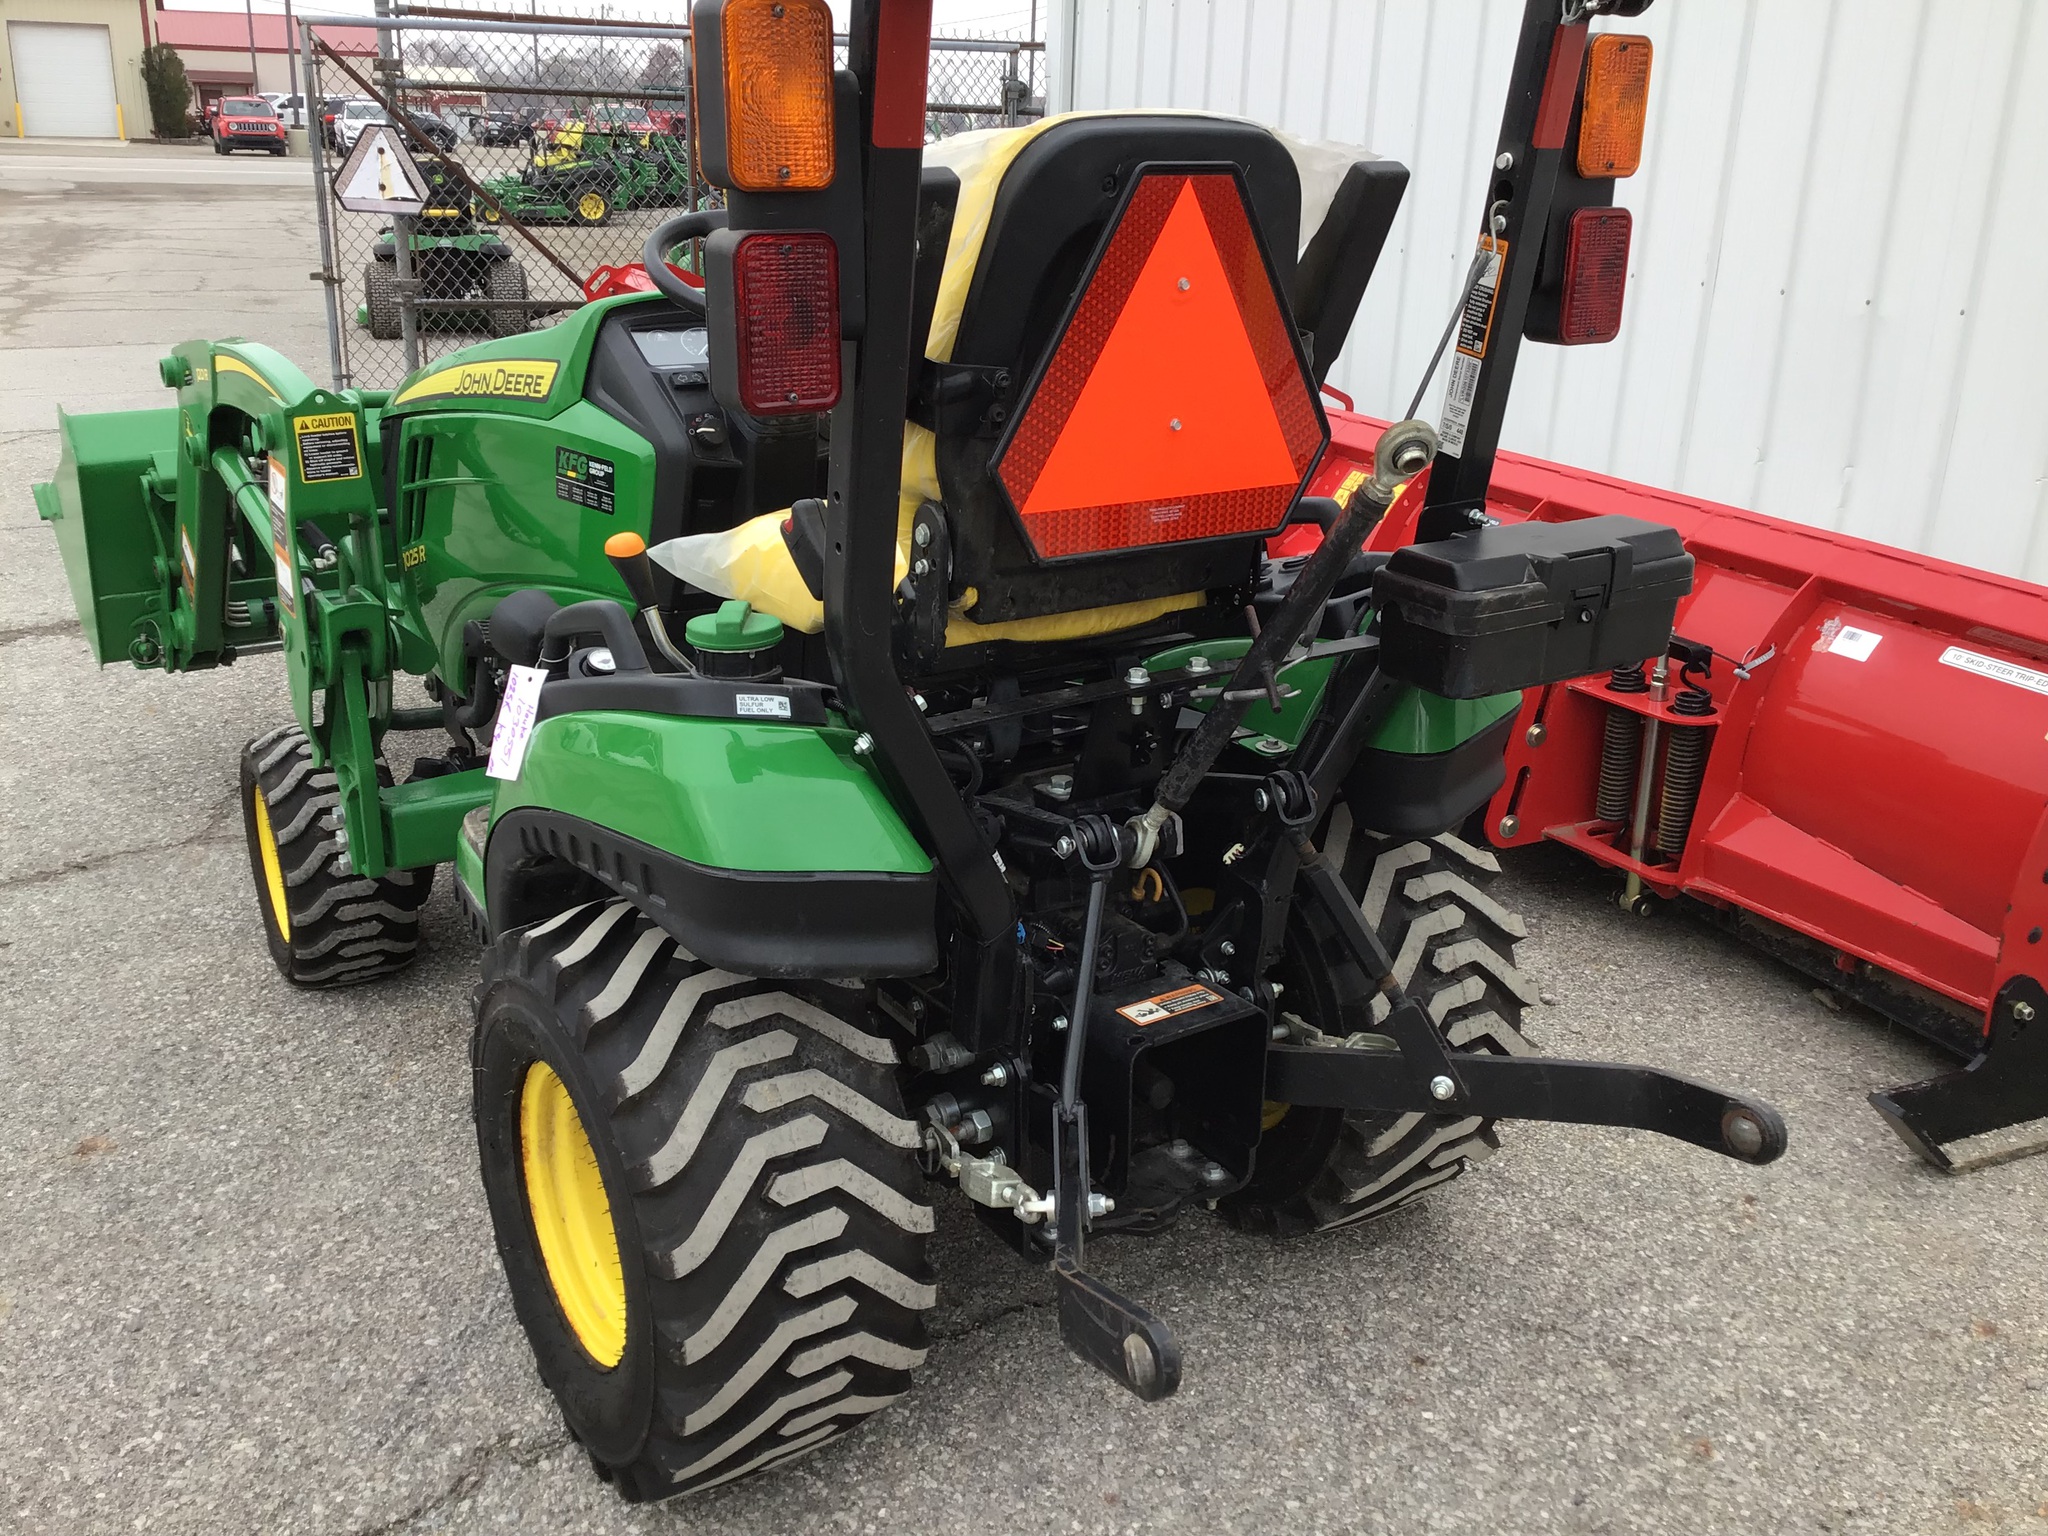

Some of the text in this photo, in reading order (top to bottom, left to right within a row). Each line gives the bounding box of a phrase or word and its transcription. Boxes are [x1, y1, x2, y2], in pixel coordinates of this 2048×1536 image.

[454, 368, 545, 394] JOHN DEERE
[1448, 379, 1456, 398] JOHN
[1453, 356, 1461, 379] DEERE
[311, 416, 352, 429] CAUTION
[558, 450, 588, 474] KFG
[588, 467, 605, 477] GROUP
[1964, 656, 2014, 677] SKID-STEER
[500, 697, 526, 767] 1030551
